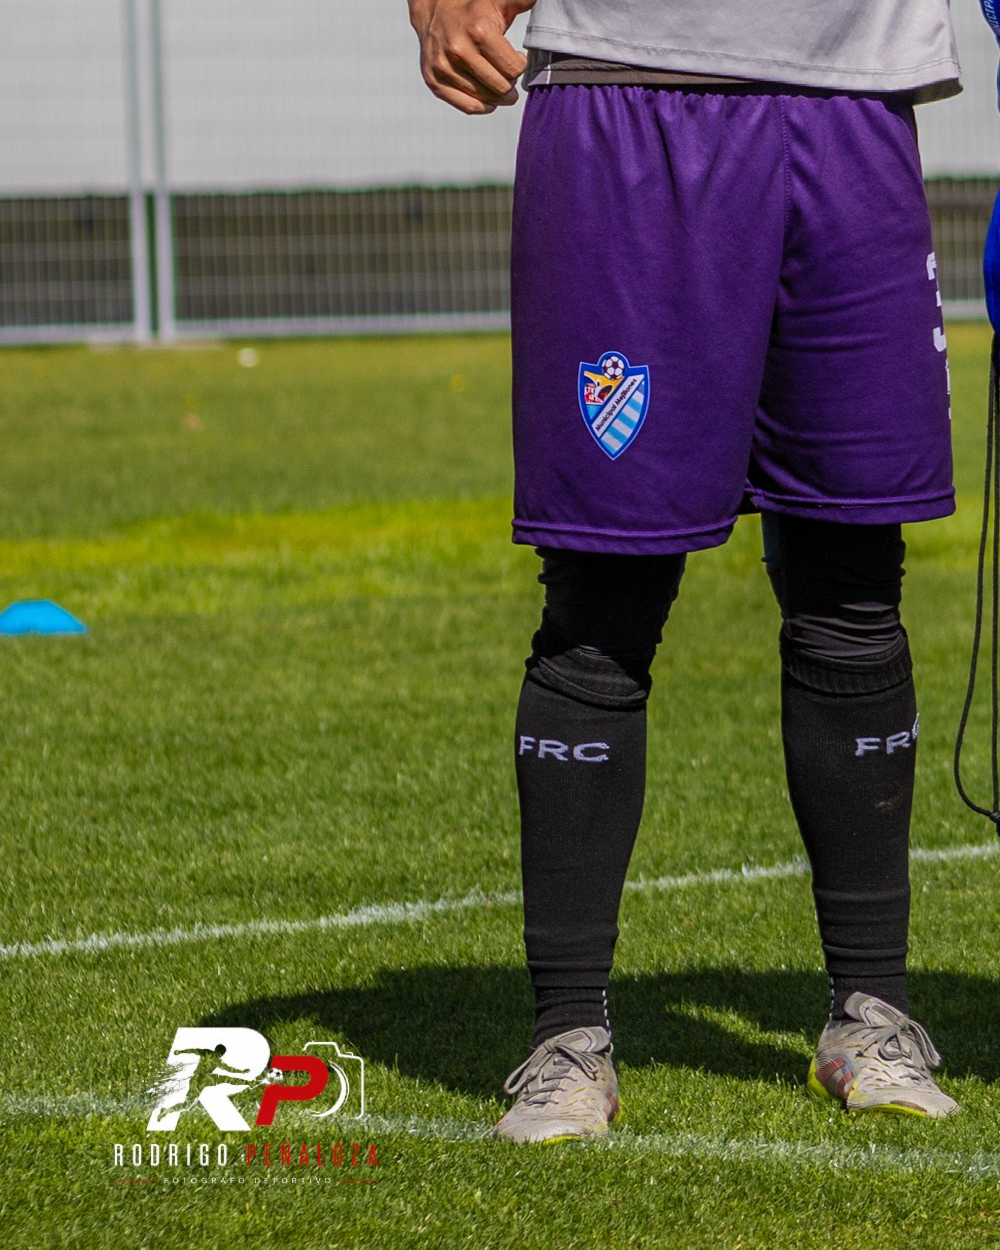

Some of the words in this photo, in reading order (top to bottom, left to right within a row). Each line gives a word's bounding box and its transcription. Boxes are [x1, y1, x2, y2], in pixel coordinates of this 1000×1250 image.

[594, 403, 618, 432] Municipal
[614, 378, 638, 406] Mejillones
[519, 735, 611, 762] FRC
